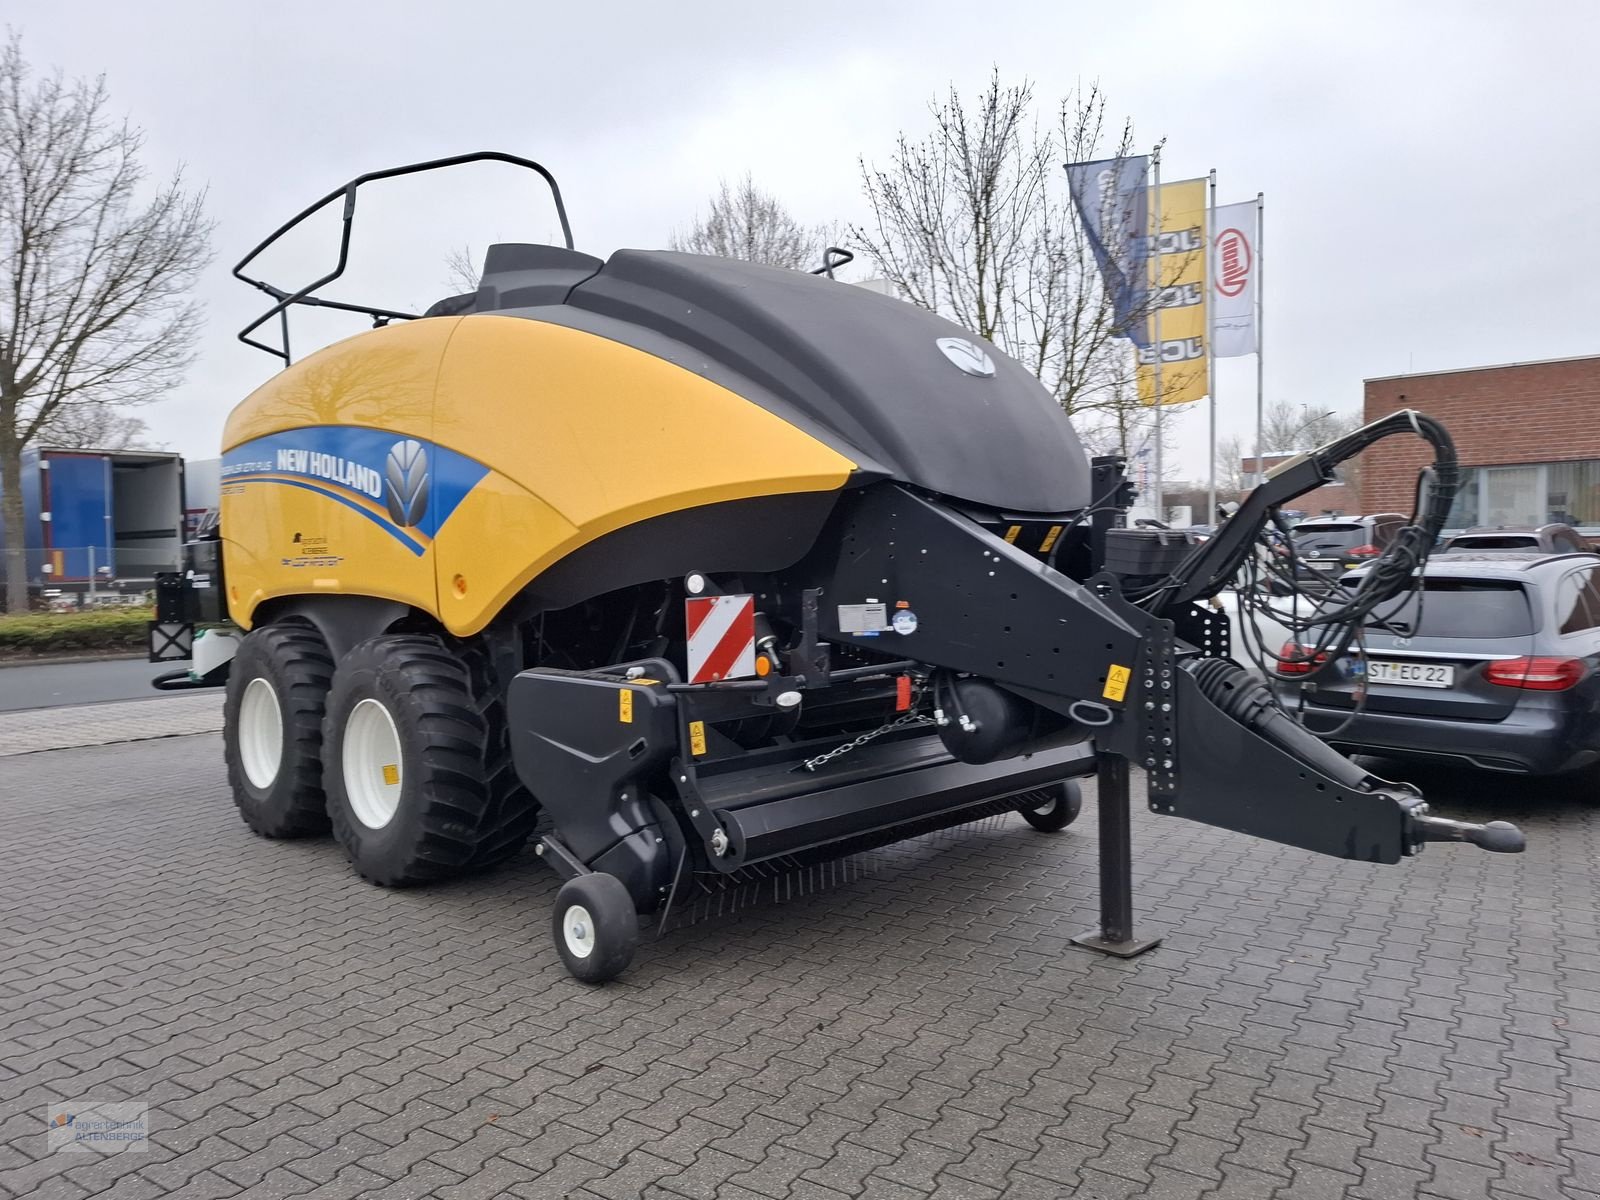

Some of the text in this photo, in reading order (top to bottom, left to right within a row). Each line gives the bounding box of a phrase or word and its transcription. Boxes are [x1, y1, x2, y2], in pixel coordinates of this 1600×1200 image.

[277, 449, 382, 499] NEW HOLLAND
[1368, 663, 1446, 682] ST EC 22
